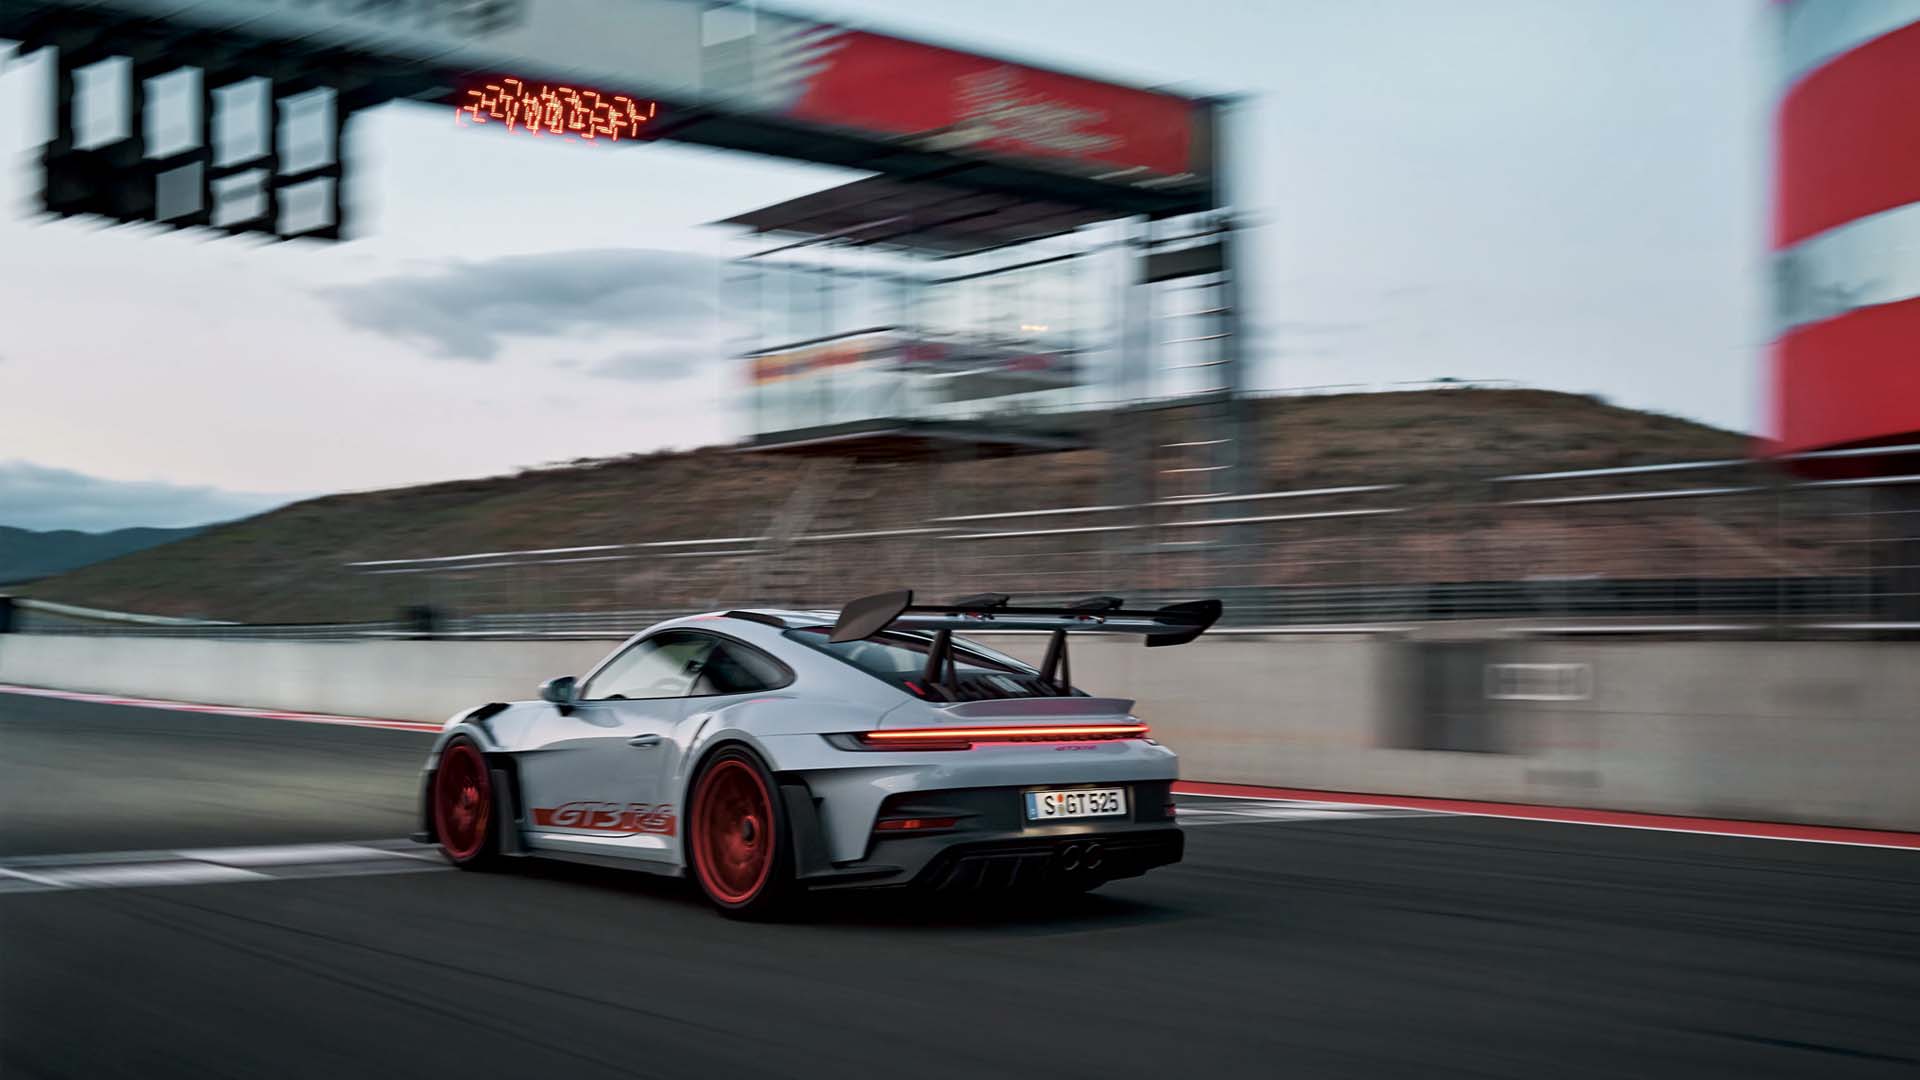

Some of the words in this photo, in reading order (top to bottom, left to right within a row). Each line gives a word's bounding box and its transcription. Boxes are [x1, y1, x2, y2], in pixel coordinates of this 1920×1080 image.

[551, 801, 621, 828] GT3
[1044, 795, 1056, 815] S
[1066, 793, 1086, 814] GT
[1088, 792, 1119, 813] 525
